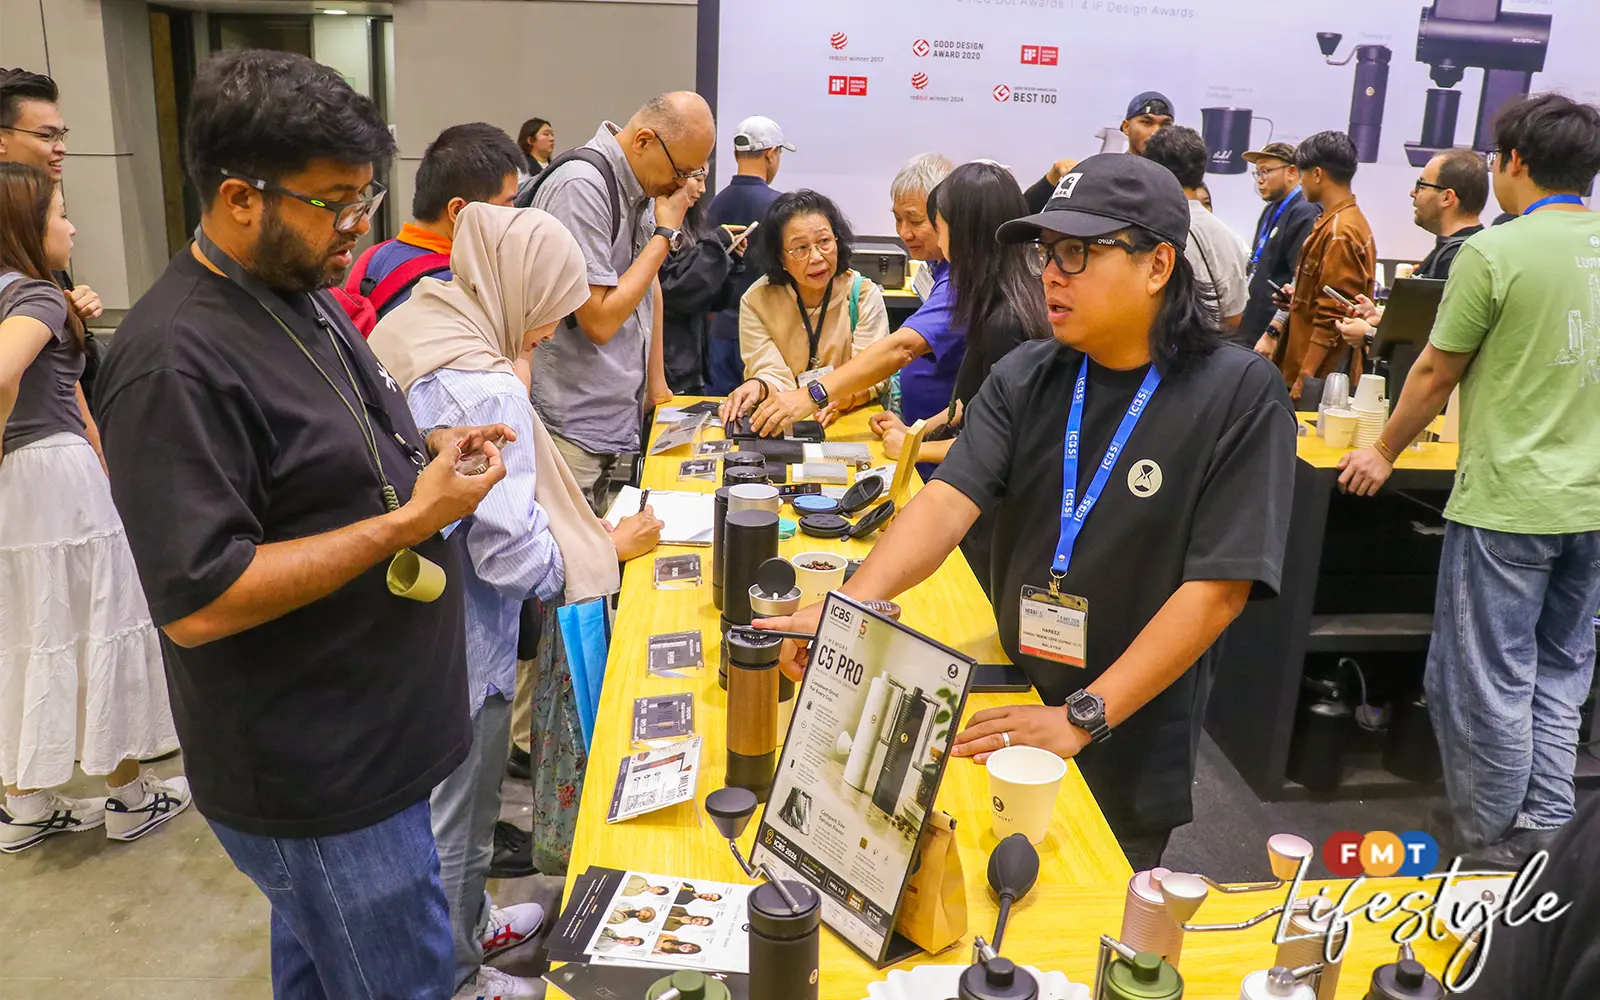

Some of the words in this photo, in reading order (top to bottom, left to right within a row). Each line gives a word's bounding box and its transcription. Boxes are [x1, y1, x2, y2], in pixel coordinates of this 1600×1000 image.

[1020, 0, 1064, 9] Awards
[1107, 2, 1148, 16] Design
[1151, 5, 1195, 18] Awards
[933, 40, 955, 48] GOOD
[956, 41, 984, 50] DESIGN
[933, 50, 960, 59] AWARD
[961, 51, 981, 60] 2020
[1013, 92, 1038, 103] BEST
[1041, 94, 1057, 104] 100
[1075, 376, 1085, 400] ICBS
[1128, 392, 1147, 417] ICBS
[1067, 430, 1078, 455] ICBS
[1101, 445, 1119, 470] ICBS
[1064, 489, 1074, 513] ICBS
[1073, 499, 1092, 522] ICBS
[830, 604, 851, 622] ICBS
[817, 644, 836, 670] C5
[835, 654, 864, 686] PRO
[773, 839, 786, 851] ICBS
